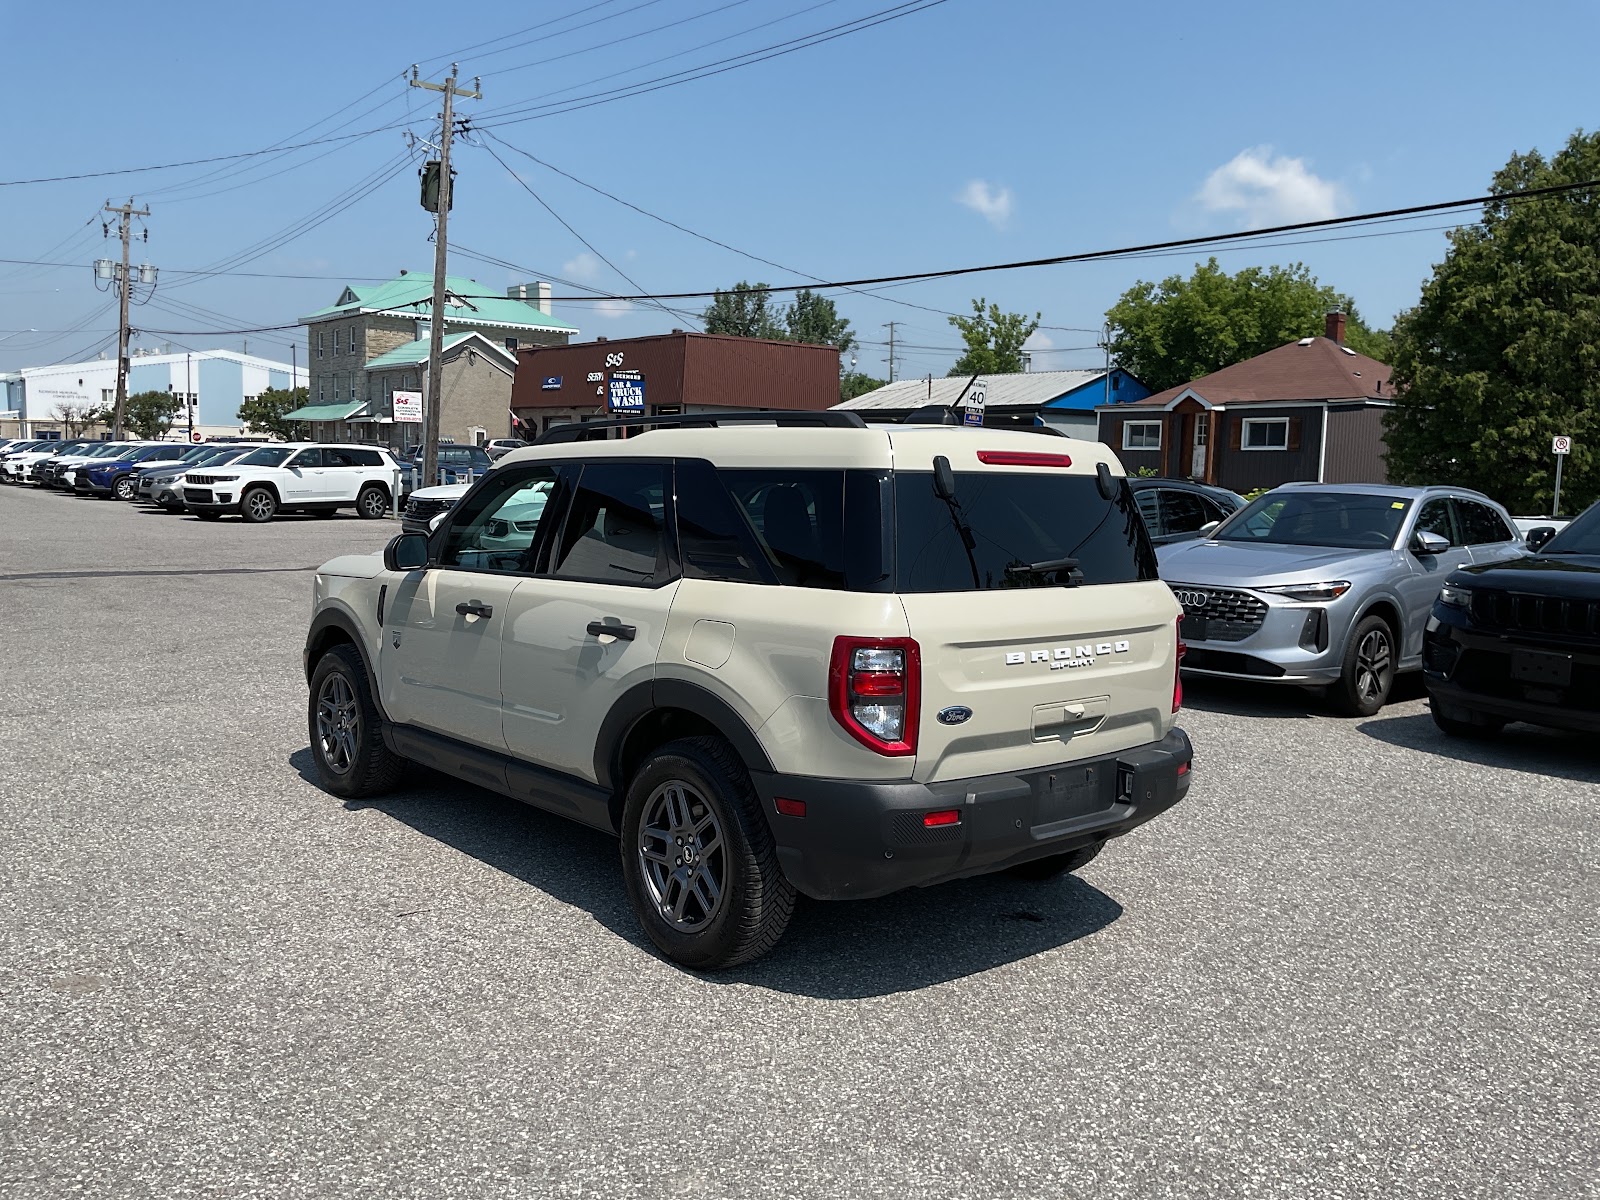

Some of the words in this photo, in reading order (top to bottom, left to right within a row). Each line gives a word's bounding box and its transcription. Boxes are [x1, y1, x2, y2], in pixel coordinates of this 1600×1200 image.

[605, 352, 624, 367] S&S
[597, 385, 604, 395] &
[611, 387, 642, 397] TRUCK
[612, 396, 643, 407] WASH
[969, 391, 985, 405] 40
[1005, 640, 1130, 665] BRONCO
[1050, 657, 1096, 670] SPORT
[945, 711, 966, 722] Ford
